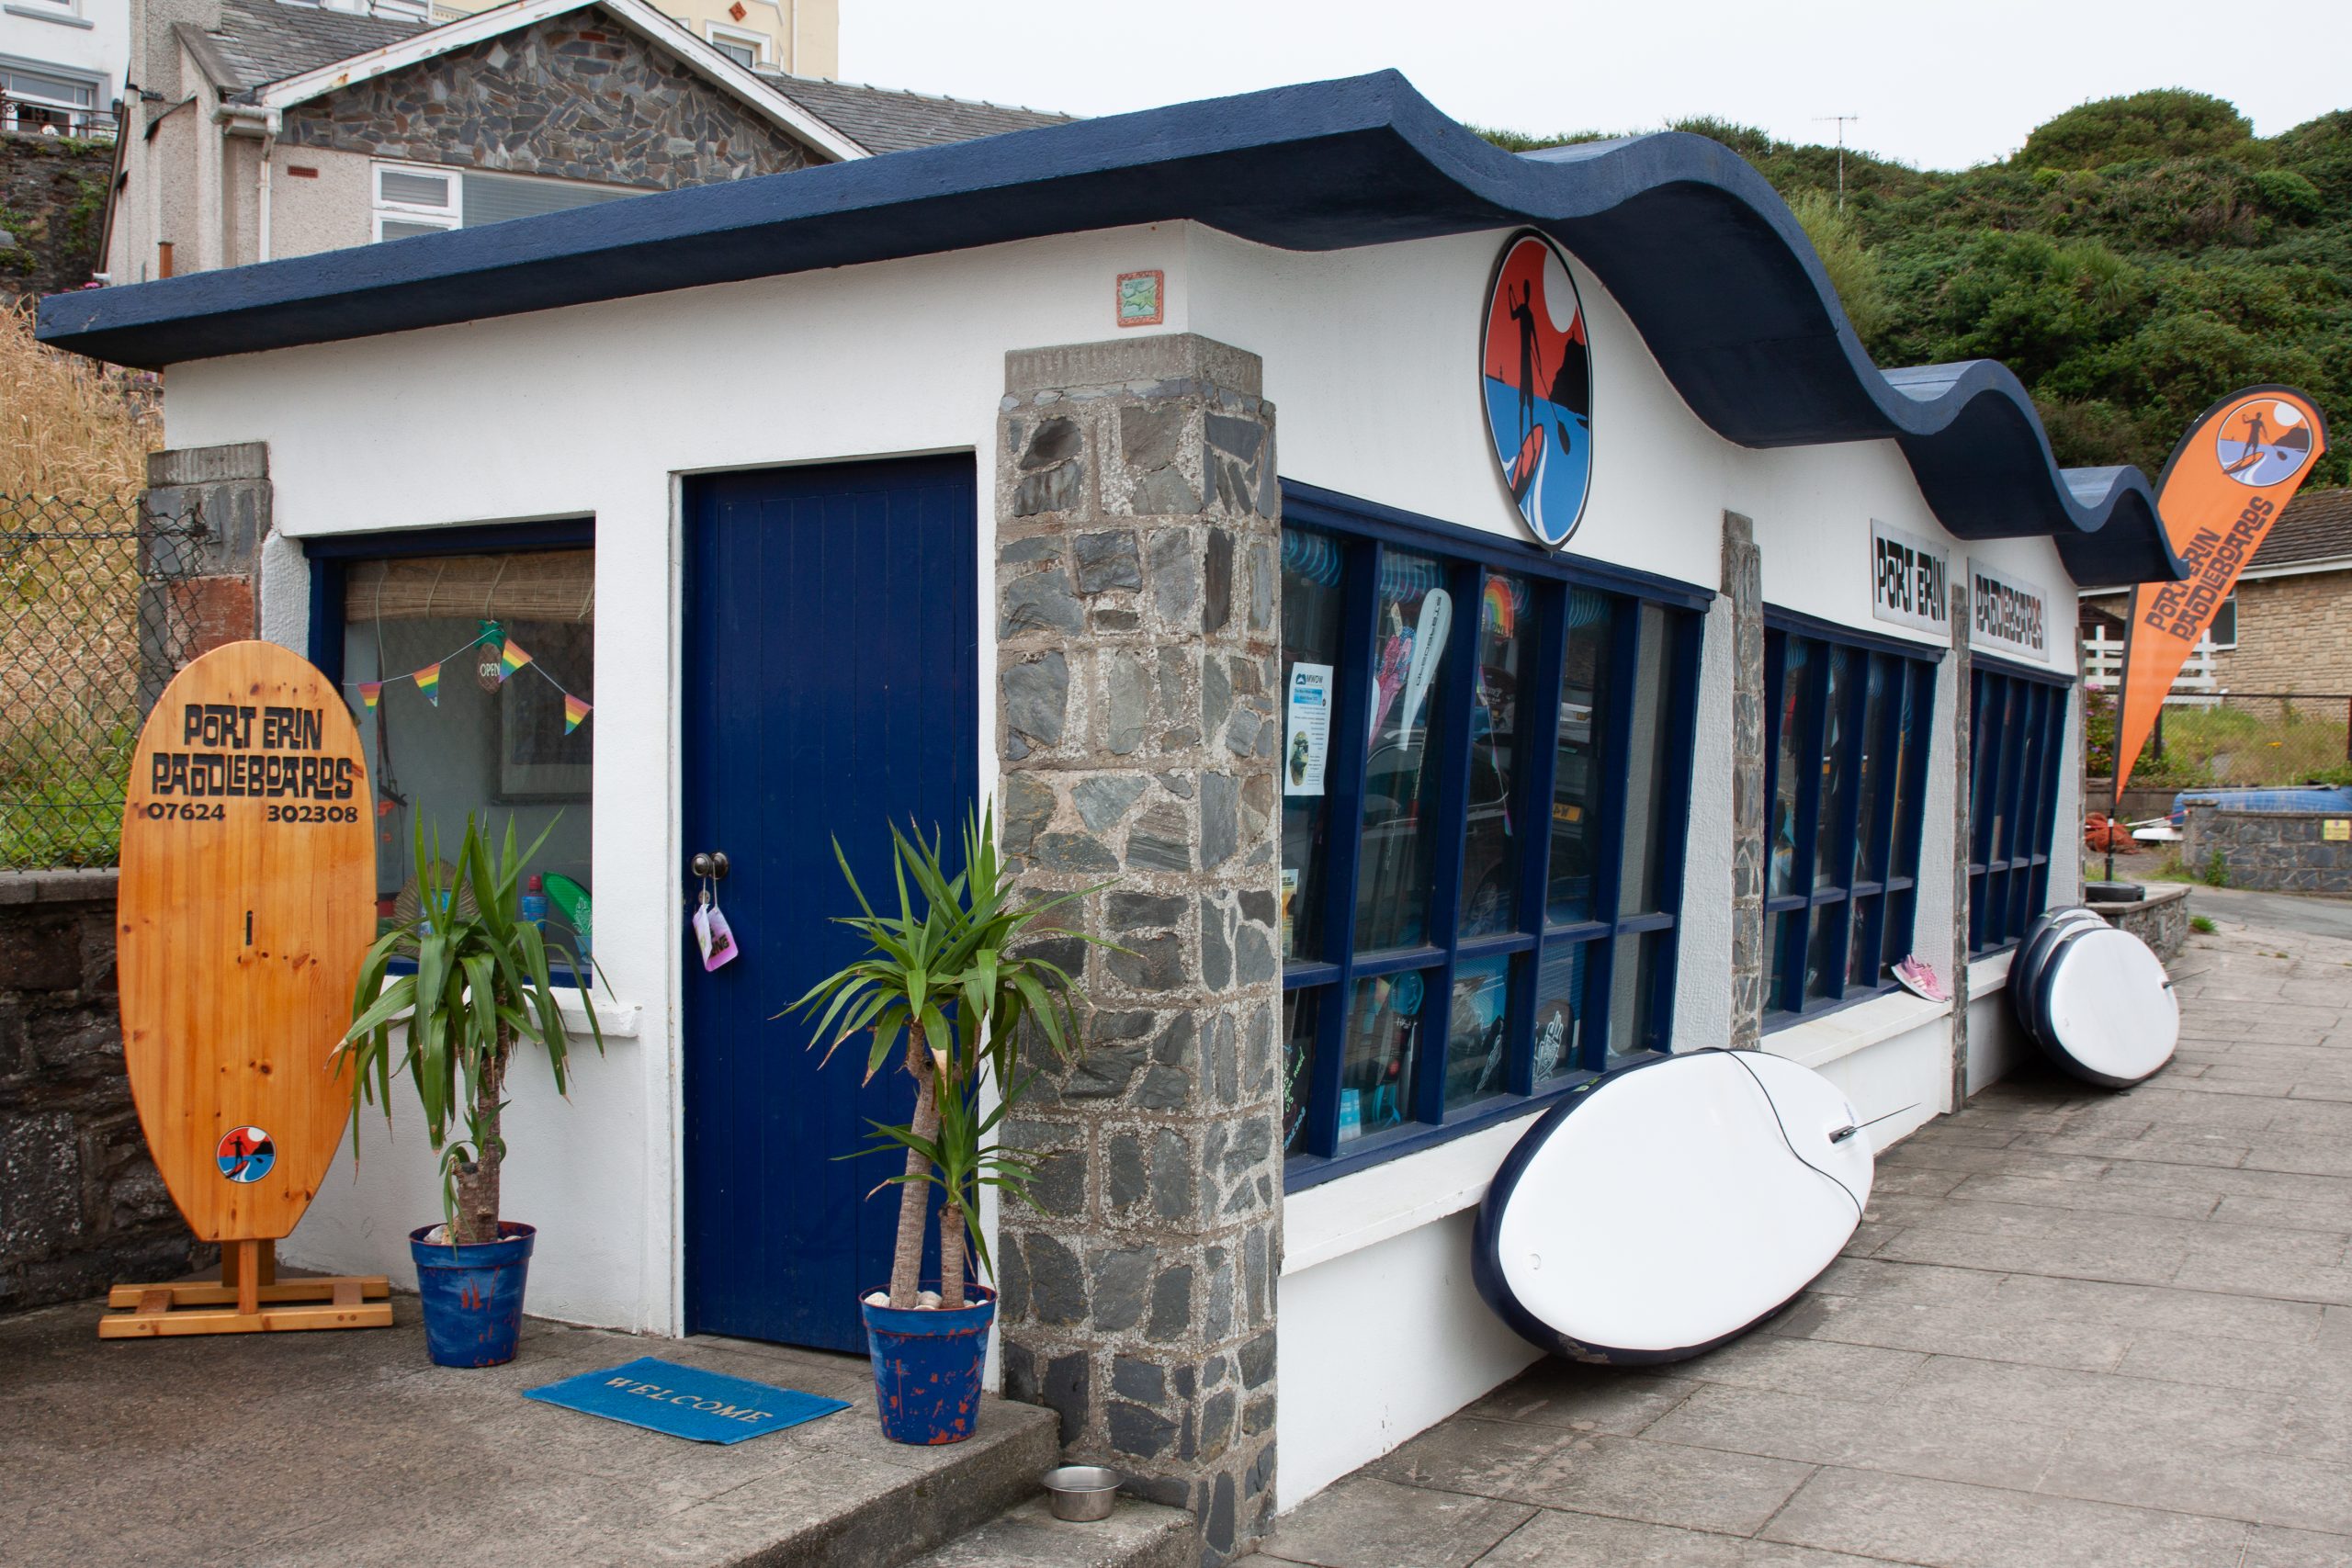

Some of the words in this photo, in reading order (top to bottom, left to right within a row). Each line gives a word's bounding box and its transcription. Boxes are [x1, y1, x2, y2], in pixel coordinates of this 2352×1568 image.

[1876, 536, 1914, 613] PORT
[1917, 551, 1946, 621] ERIN
[2169, 495, 2275, 642] PADDLEBOARDS
[1975, 573, 2043, 650] PADDLEBOARDS
[480, 662, 501, 677] OPEN
[184, 704, 256, 750] PORT
[263, 706, 323, 750] ERIN
[152, 751, 354, 800] PADDLEBOARDS
[146, 802, 226, 821] 07624
[267, 805, 358, 823] 302308
[604, 1378, 774, 1424] WELCOME
